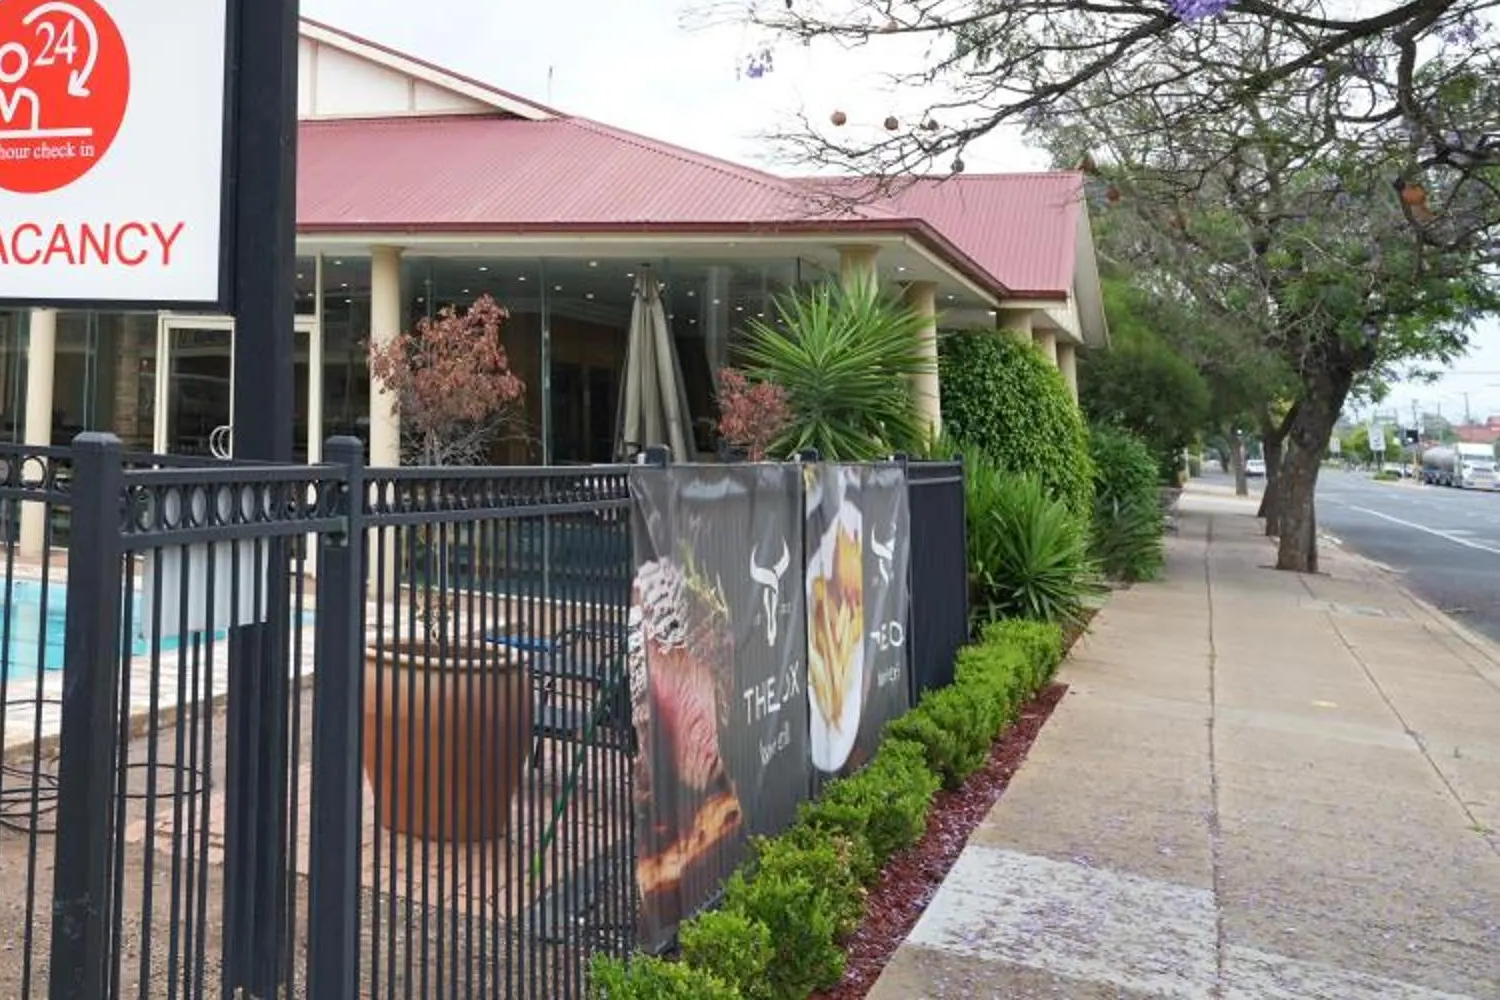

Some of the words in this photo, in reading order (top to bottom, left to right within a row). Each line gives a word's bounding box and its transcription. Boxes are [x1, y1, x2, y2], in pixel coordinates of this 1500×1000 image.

[33, 19, 77, 67] 24
[33, 140, 75, 159] check
[80, 140, 95, 157] in
[743, 675, 781, 725] THE
